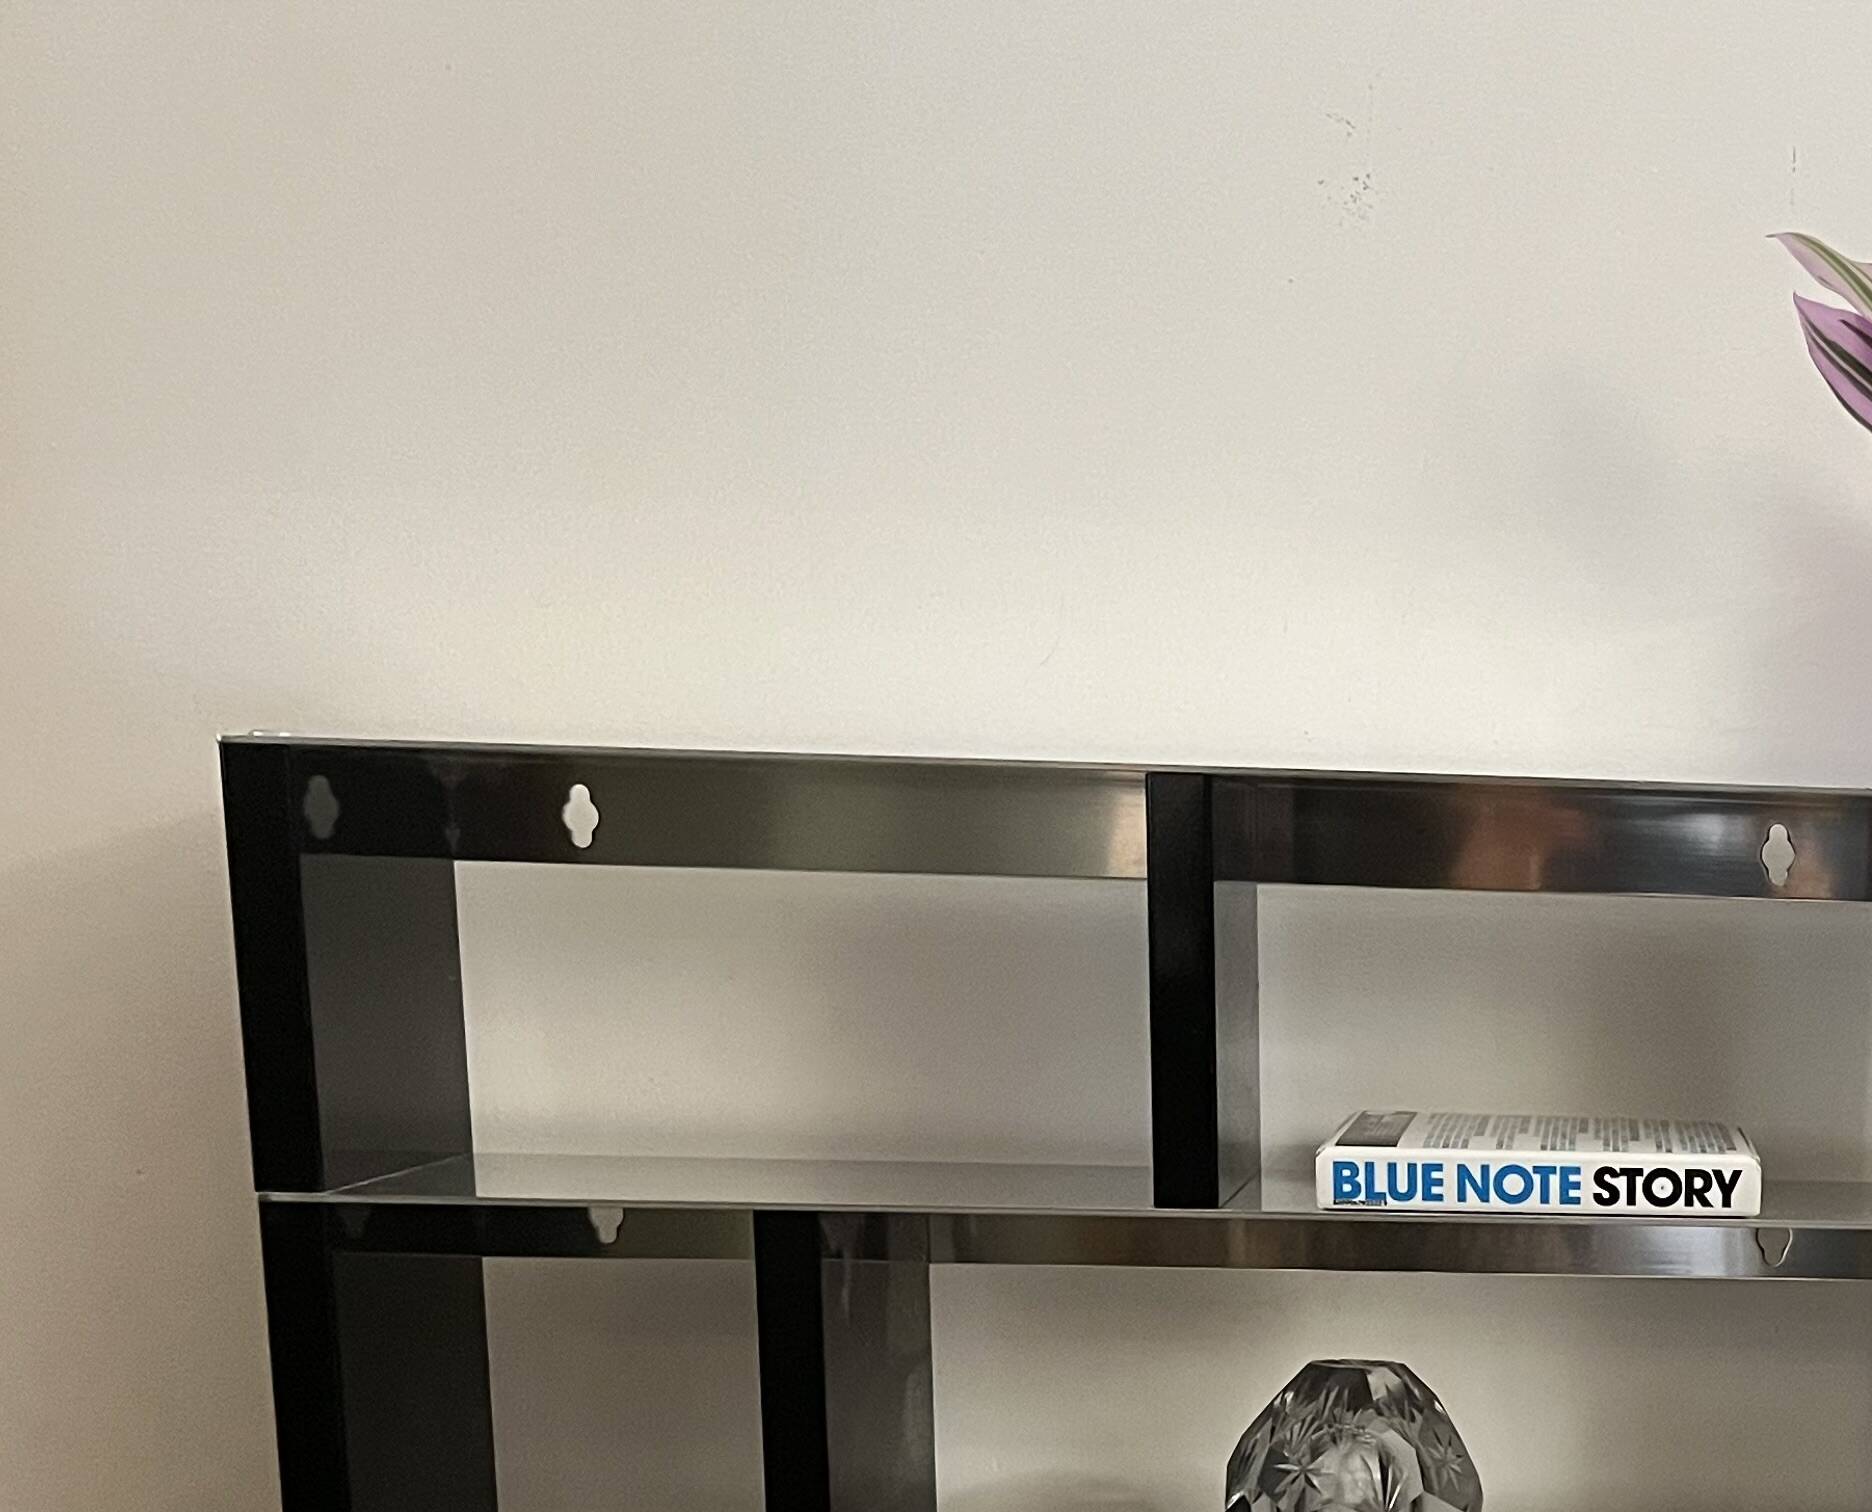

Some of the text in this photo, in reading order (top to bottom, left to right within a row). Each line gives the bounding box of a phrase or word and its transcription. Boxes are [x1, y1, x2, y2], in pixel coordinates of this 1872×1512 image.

[1333, 1161, 1742, 1208] BLUE NOTE STORY
